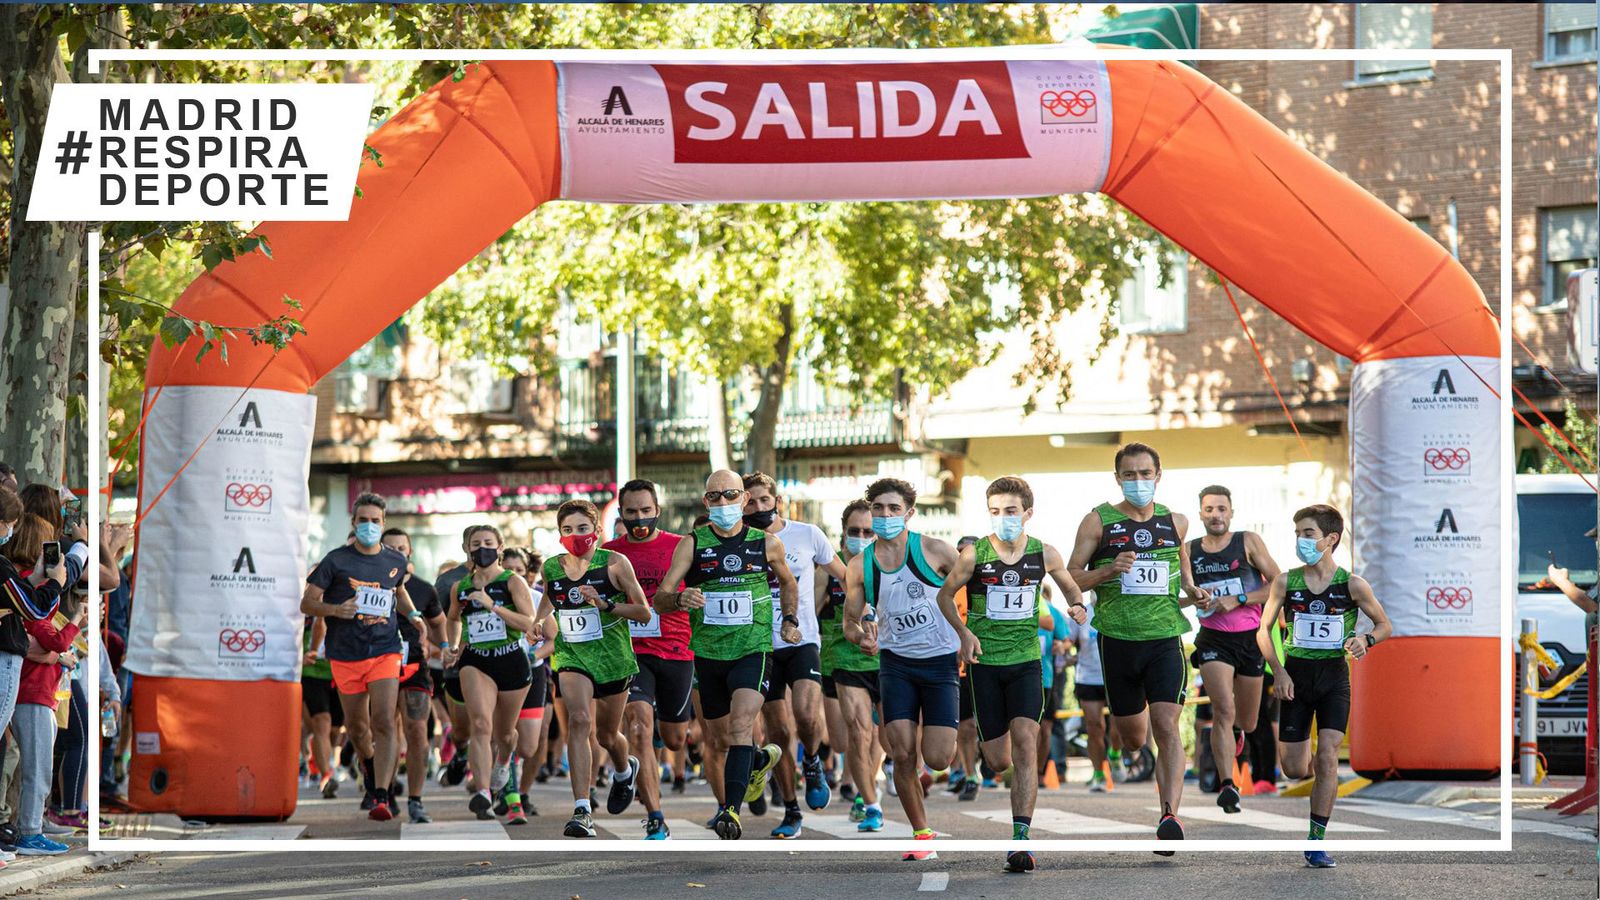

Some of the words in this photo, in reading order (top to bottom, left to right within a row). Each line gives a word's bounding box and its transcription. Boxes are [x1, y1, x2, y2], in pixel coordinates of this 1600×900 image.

[684, 79, 1003, 141] SALIDA
[578, 117, 609, 125] ALCALÁ
[1135, 568, 1158, 584] 30
[363, 593, 387, 608] 106
[717, 599, 739, 615] 10
[1003, 594, 1023, 609] 14
[477, 619, 494, 633] 26
[568, 616, 587, 632] 19
[894, 610, 927, 631] 306
[1309, 622, 1331, 638] 15
[494, 641, 519, 657] NIKE
